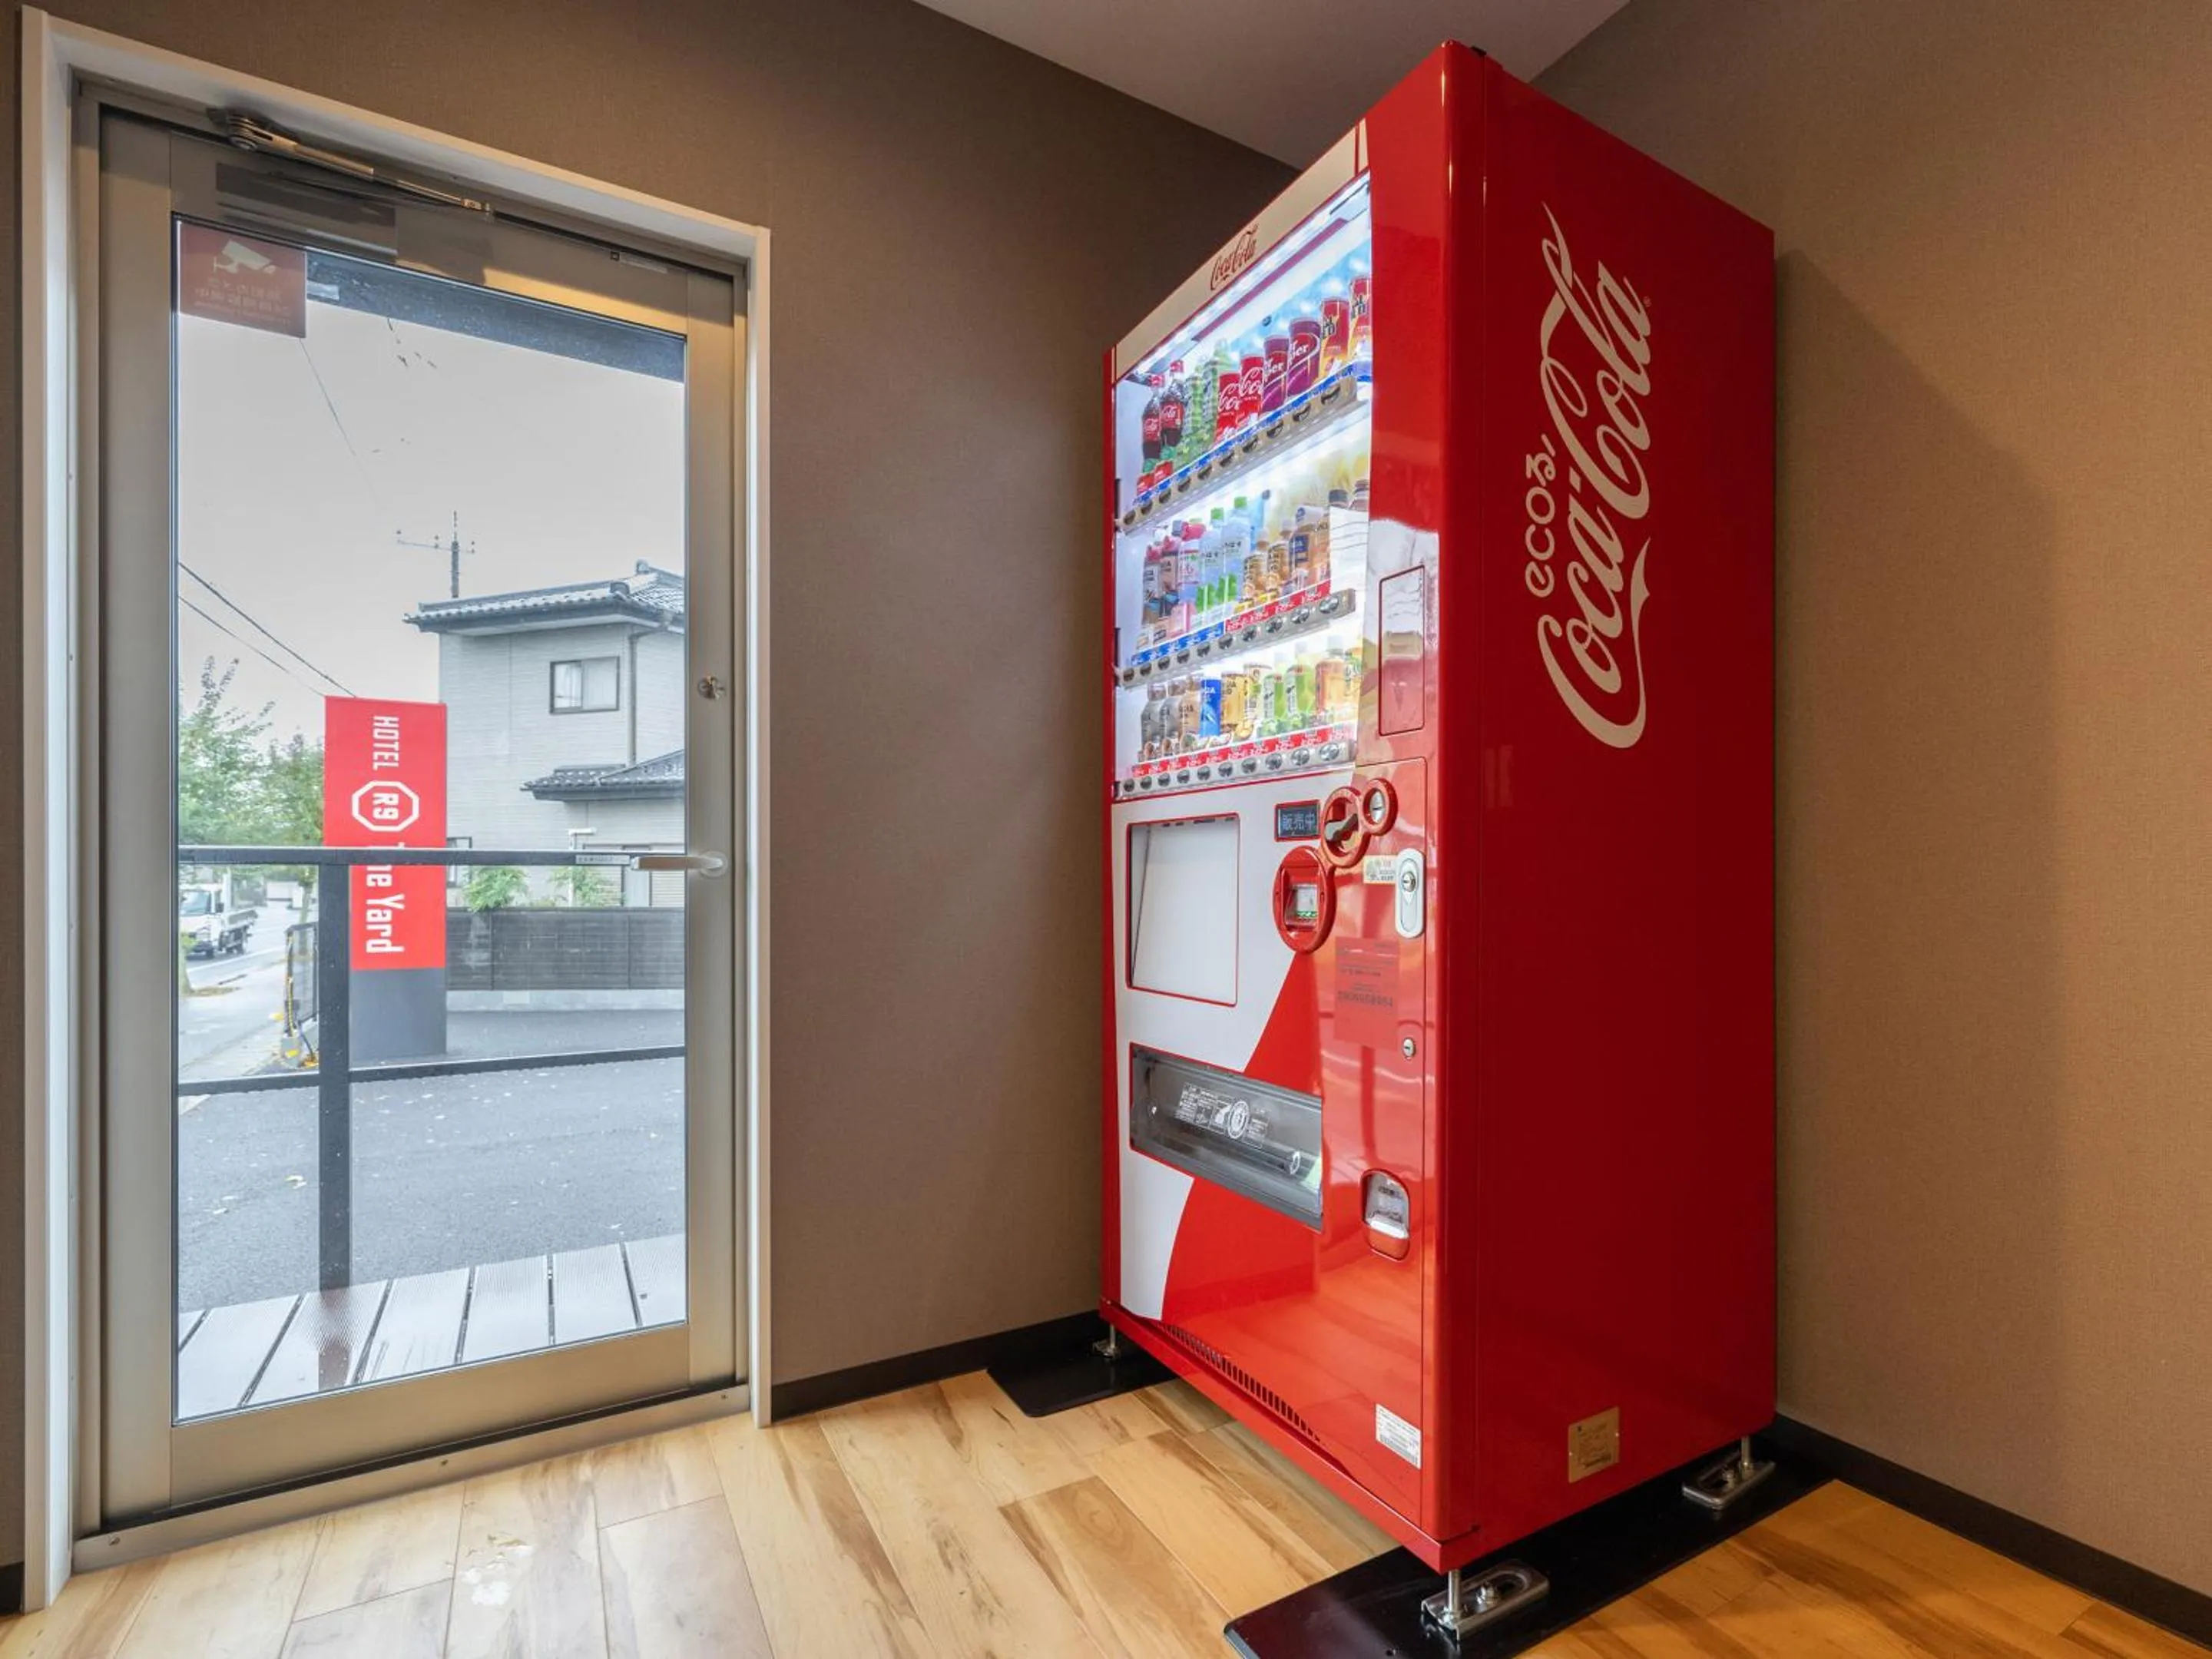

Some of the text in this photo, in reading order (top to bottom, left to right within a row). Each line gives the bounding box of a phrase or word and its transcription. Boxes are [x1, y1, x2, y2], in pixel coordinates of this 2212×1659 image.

[1538, 200, 1651, 748] Coca-Cola
[373, 715, 399, 771] HOTEL
[373, 793, 399, 820] R9
[366, 893, 406, 954] Yard
